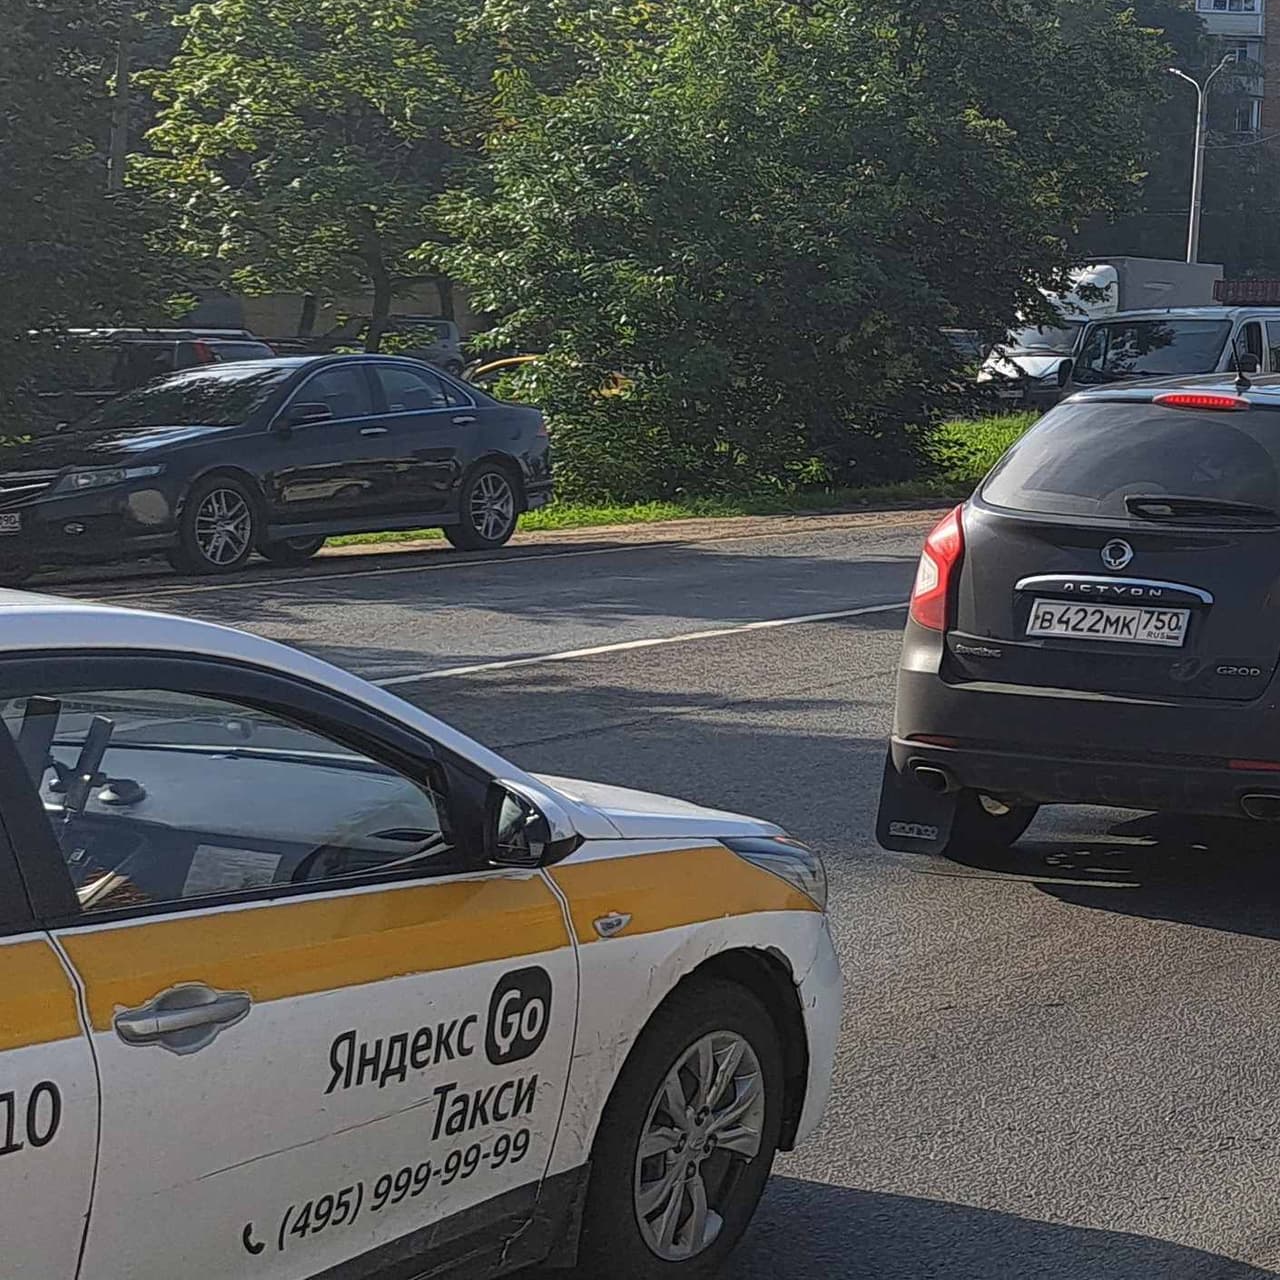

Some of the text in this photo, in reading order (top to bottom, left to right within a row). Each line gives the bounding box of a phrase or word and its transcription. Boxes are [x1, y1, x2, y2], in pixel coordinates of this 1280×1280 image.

[1063, 582, 1163, 597] ACTYON
[1038, 606, 1181, 637] В422МК 750
[1146, 631, 1167, 640] RUS
[323, 988, 545, 1095] Яндекс Go
[431, 1073, 538, 1141] Такси
[278, 1128, 531, 1251] (495) 999-99-99
